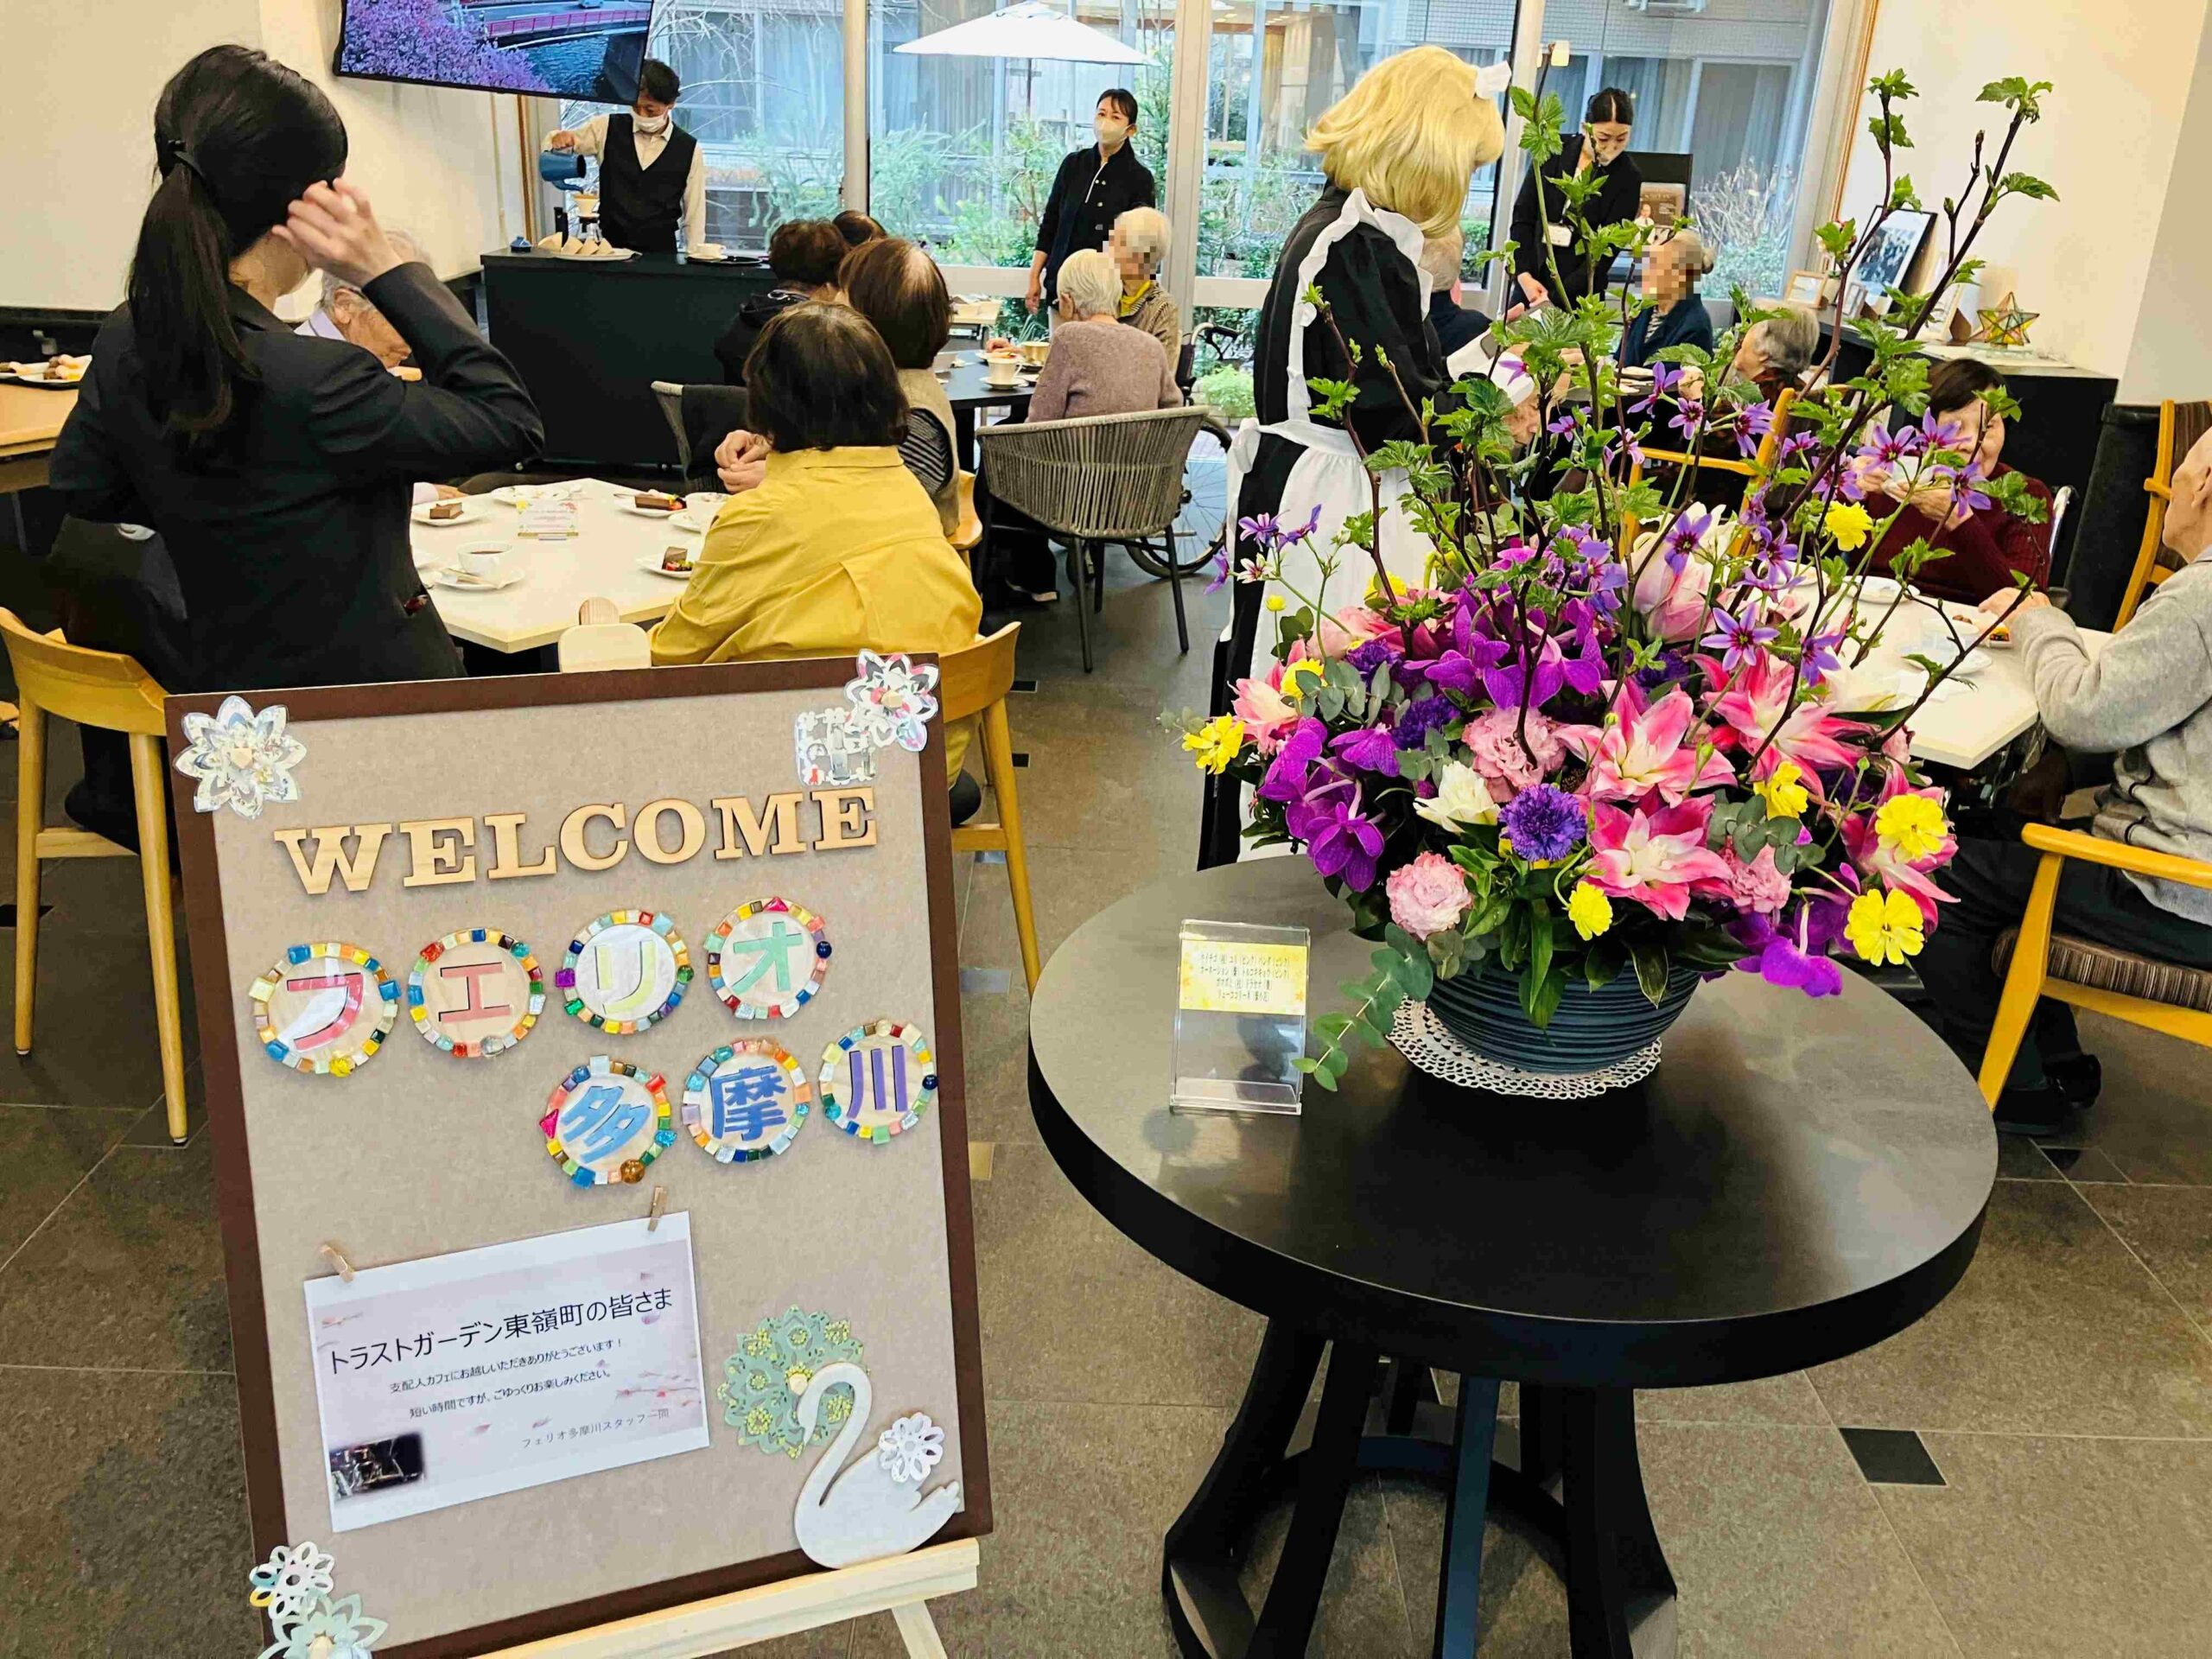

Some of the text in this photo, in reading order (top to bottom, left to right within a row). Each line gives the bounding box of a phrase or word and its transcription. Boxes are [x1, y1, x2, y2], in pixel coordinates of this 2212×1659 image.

[274, 786, 877, 895] WELCOME
[562, 1045, 909, 1164] 多摩川
[332, 1287, 672, 1375] トラストガーデン東嶺町の皆さま
